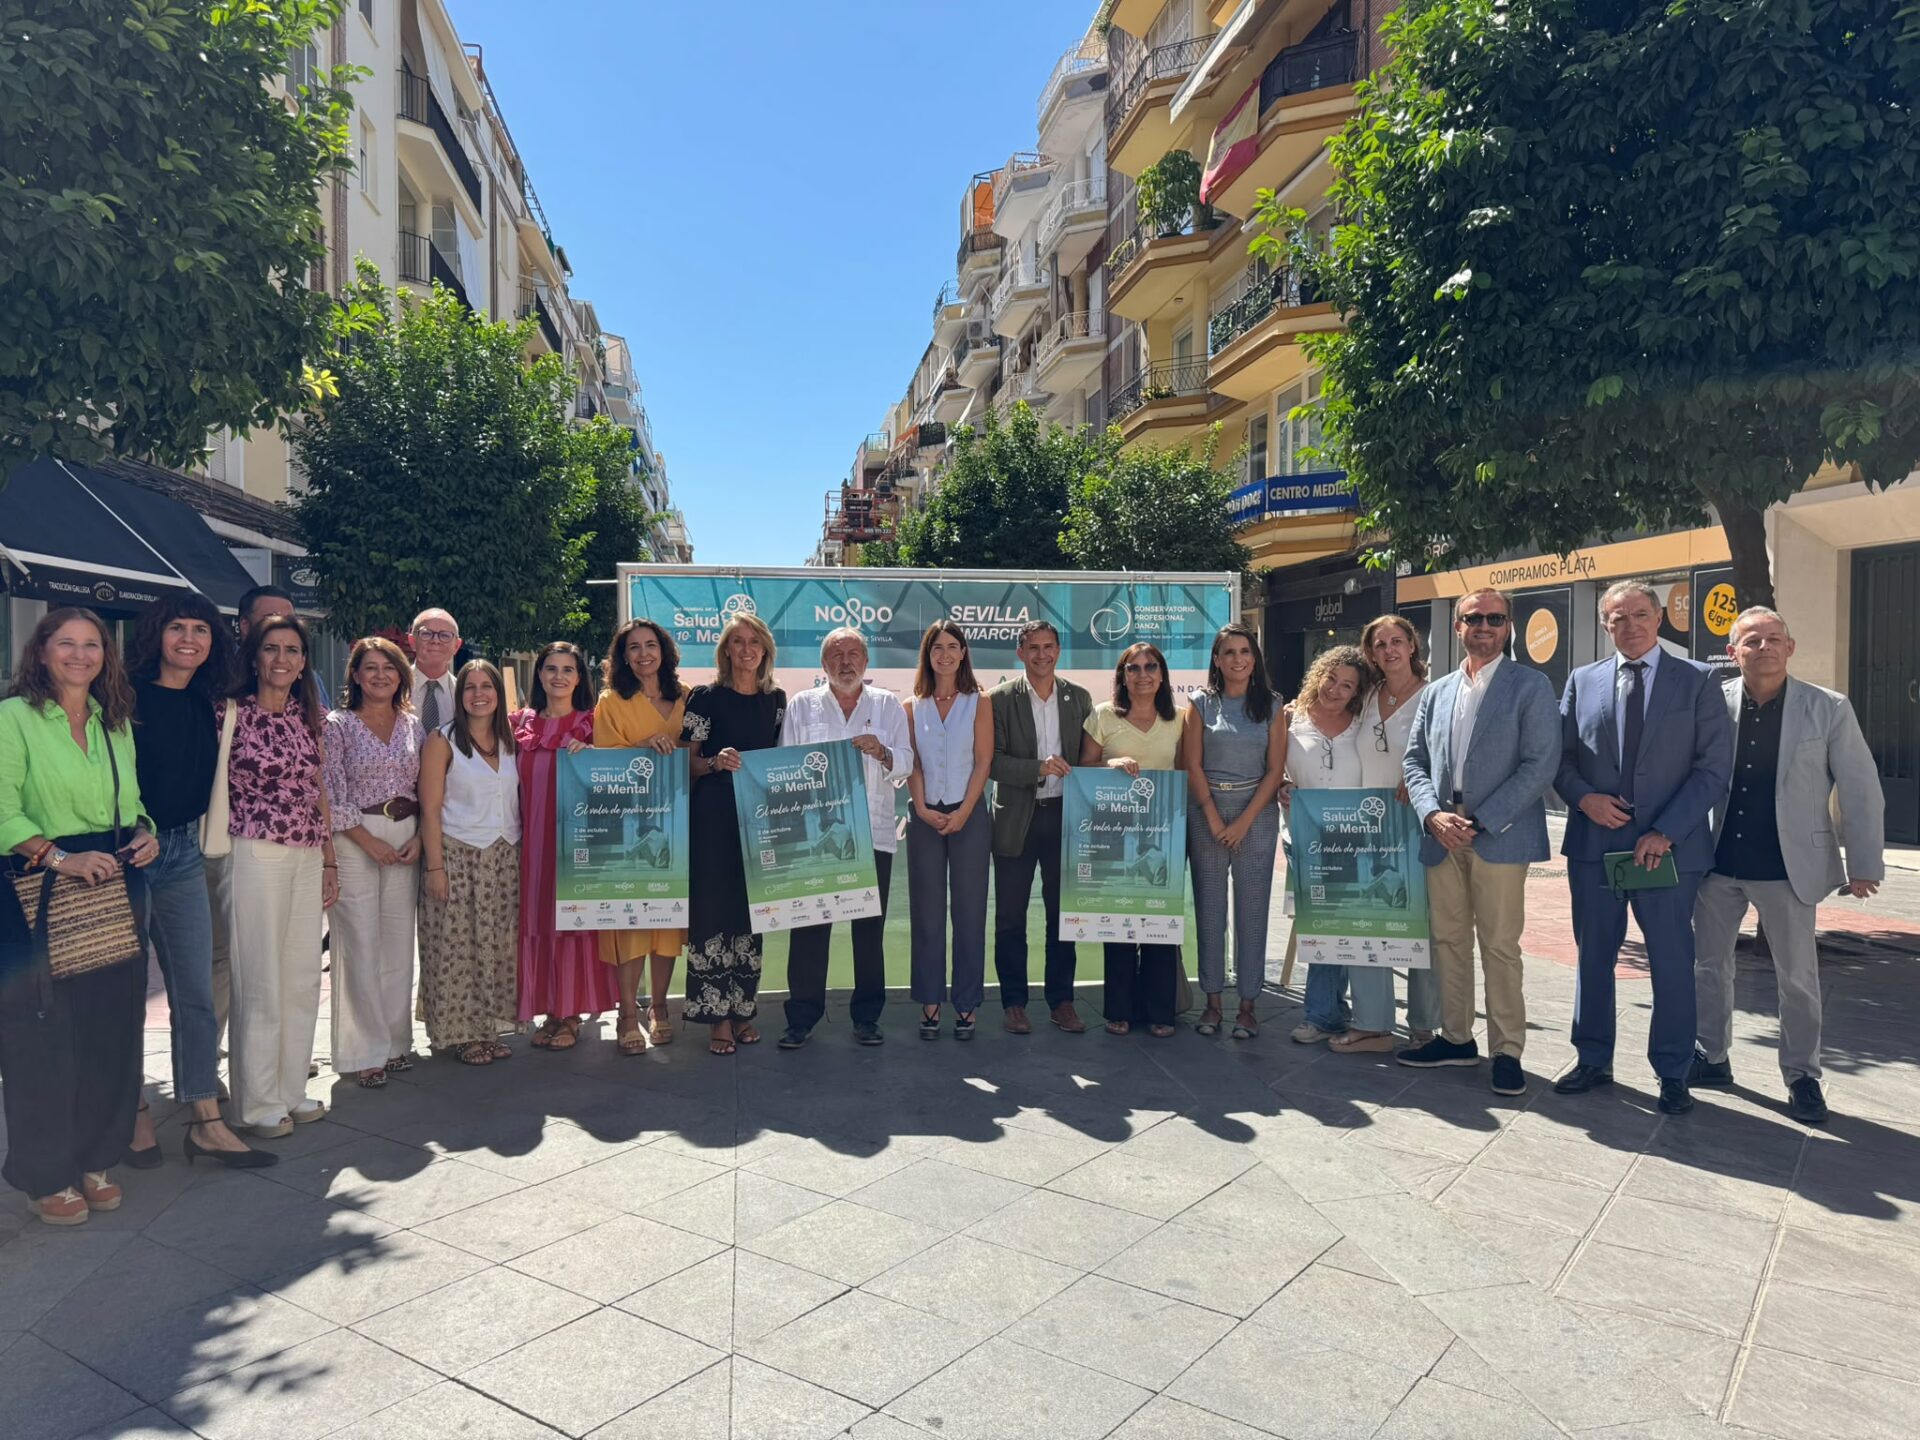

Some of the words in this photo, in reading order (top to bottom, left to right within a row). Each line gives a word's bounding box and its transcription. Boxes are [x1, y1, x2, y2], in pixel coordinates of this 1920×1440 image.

[1270, 485, 1310, 500] CENTRO
[1489, 562, 1557, 585] COMPRAMOS
[1560, 556, 1596, 575] PLATA
[1134, 605, 1196, 613] CONSERVATORIO
[1315, 594, 1343, 621] global
[1713, 591, 1736, 614] 125
[673, 613, 719, 627] Salud
[949, 604, 1030, 622] SEVILLA
[1134, 622, 1160, 630] DANZA
[871, 634, 893, 642] SEVILLA
[961, 627, 1022, 640] MARCH
[591, 772, 625, 783] Salud
[767, 769, 801, 783] Salud
[607, 784, 649, 794] Mental
[785, 778, 826, 793] Mental
[1095, 790, 1128, 801] Salud
[574, 802, 588, 817] El
[610, 804, 621, 815] de
[620, 804, 644, 819] pedir
[645, 800, 671, 820] ayuda
[755, 804, 769, 818] El
[790, 801, 800, 812] de
[801, 800, 823, 817] pedir
[825, 791, 850, 813] ayuda
[1110, 803, 1150, 813] Mental
[1322, 811, 1357, 822] Salud
[1078, 818, 1092, 833] El
[1112, 821, 1122, 832] de
[1121, 822, 1144, 837] pedir
[1146, 819, 1170, 838] ayuda
[1340, 823, 1382, 833] Mental
[1308, 841, 1321, 855] El
[1343, 842, 1354, 853] de
[1353, 842, 1377, 858] pedir
[1379, 838, 1406, 858] ayuda
